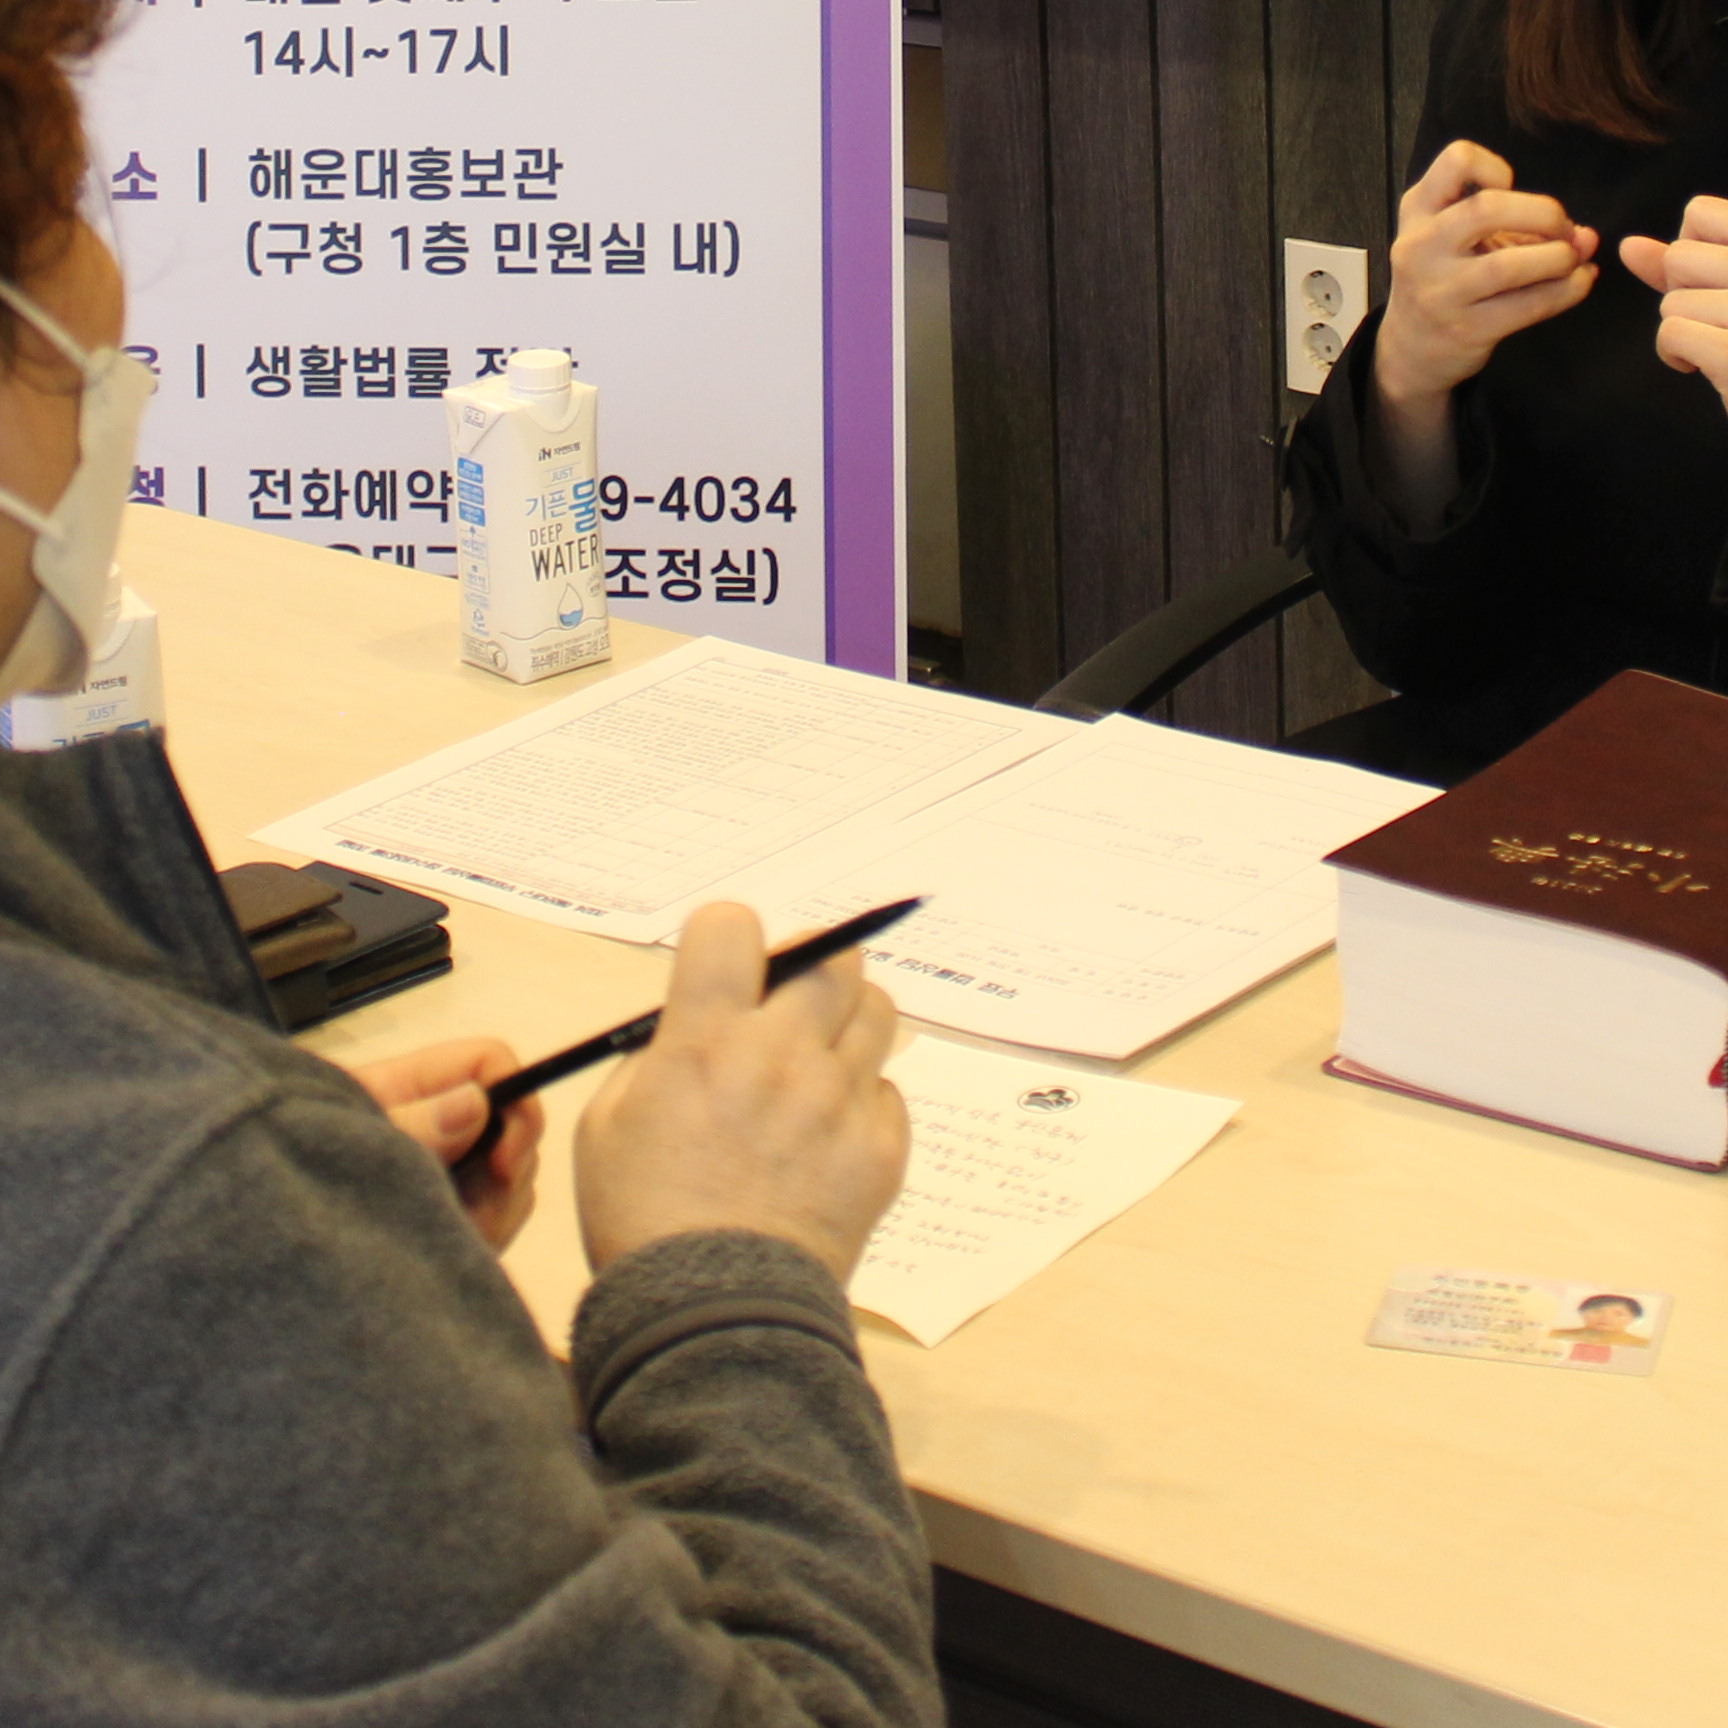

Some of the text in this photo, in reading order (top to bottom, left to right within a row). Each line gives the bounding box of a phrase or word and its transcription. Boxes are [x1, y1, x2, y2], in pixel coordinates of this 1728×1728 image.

[242, 23, 512, 79] 14시~17시
[111, 146, 564, 203] 소 해운대홍보관
[244, 219, 742, 278] (구청 1층 민원실 내)
[244, 344, 453, 401] 생활법률
[247, 468, 454, 524] 전화예약
[597, 475, 797, 526] 9-4034
[525, 489, 568, 521] 기픈
[568, 478, 598, 534] 물
[529, 523, 563, 547] DEEP
[531, 533, 600, 582] WATER
[604, 547, 779, 606] 조정실)
[85, 705, 117, 722] JUST
